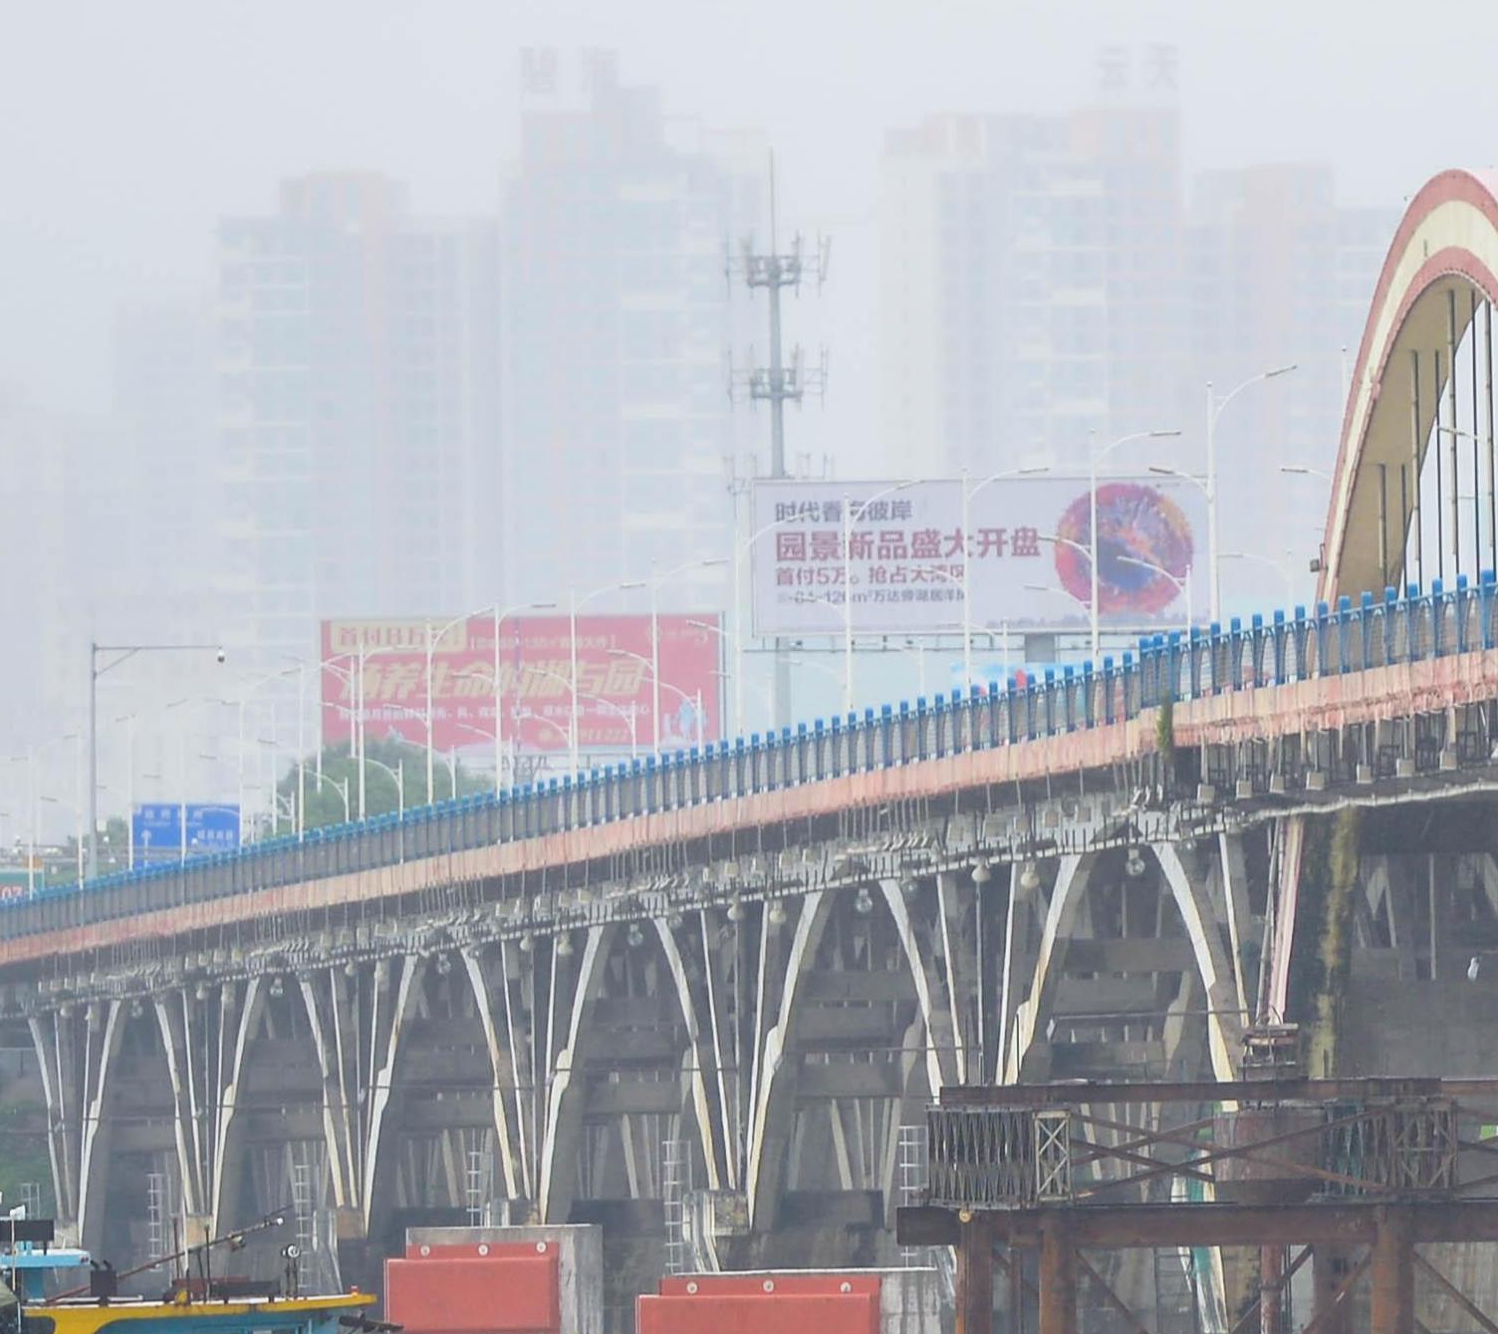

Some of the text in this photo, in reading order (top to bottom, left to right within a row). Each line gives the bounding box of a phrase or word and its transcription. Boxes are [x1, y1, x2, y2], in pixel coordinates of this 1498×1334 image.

[775, 527, 1042, 562] 园景新品盛大开盘
